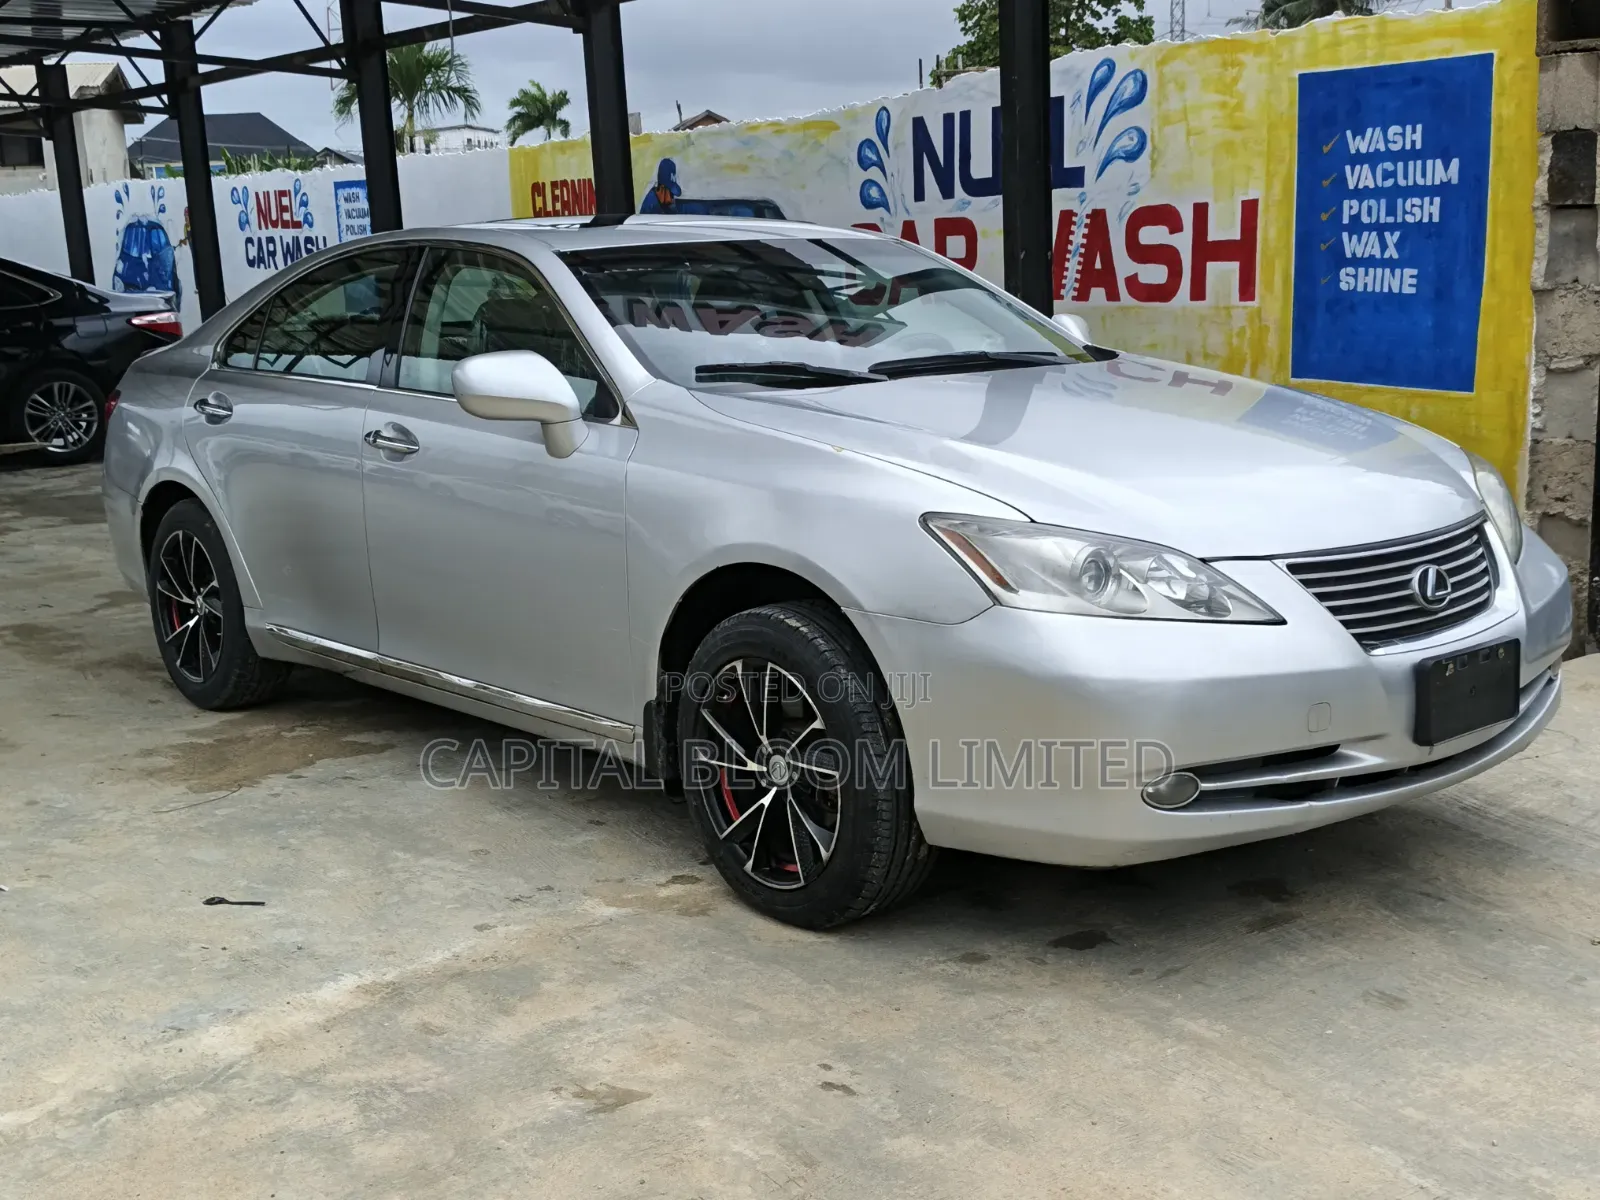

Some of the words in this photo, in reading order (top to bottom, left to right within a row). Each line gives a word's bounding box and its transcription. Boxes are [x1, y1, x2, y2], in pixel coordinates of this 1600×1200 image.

[912, 95, 1085, 203] NUL
[1346, 123, 1423, 155] WASH
[1344, 157, 1460, 190] VACUUM
[255, 189, 303, 231] NUEL
[342, 191, 361, 204] WASH
[343, 207, 370, 220] VACUUM
[531, 178, 598, 218] CLEANIN
[1341, 196, 1441, 225] POLISH
[345, 223, 368, 236] POLISH
[1341, 230, 1401, 259] WAX
[244, 235, 279, 271] CAR
[1052, 198, 1260, 303] ASH
[1339, 266, 1419, 294] SHINE
